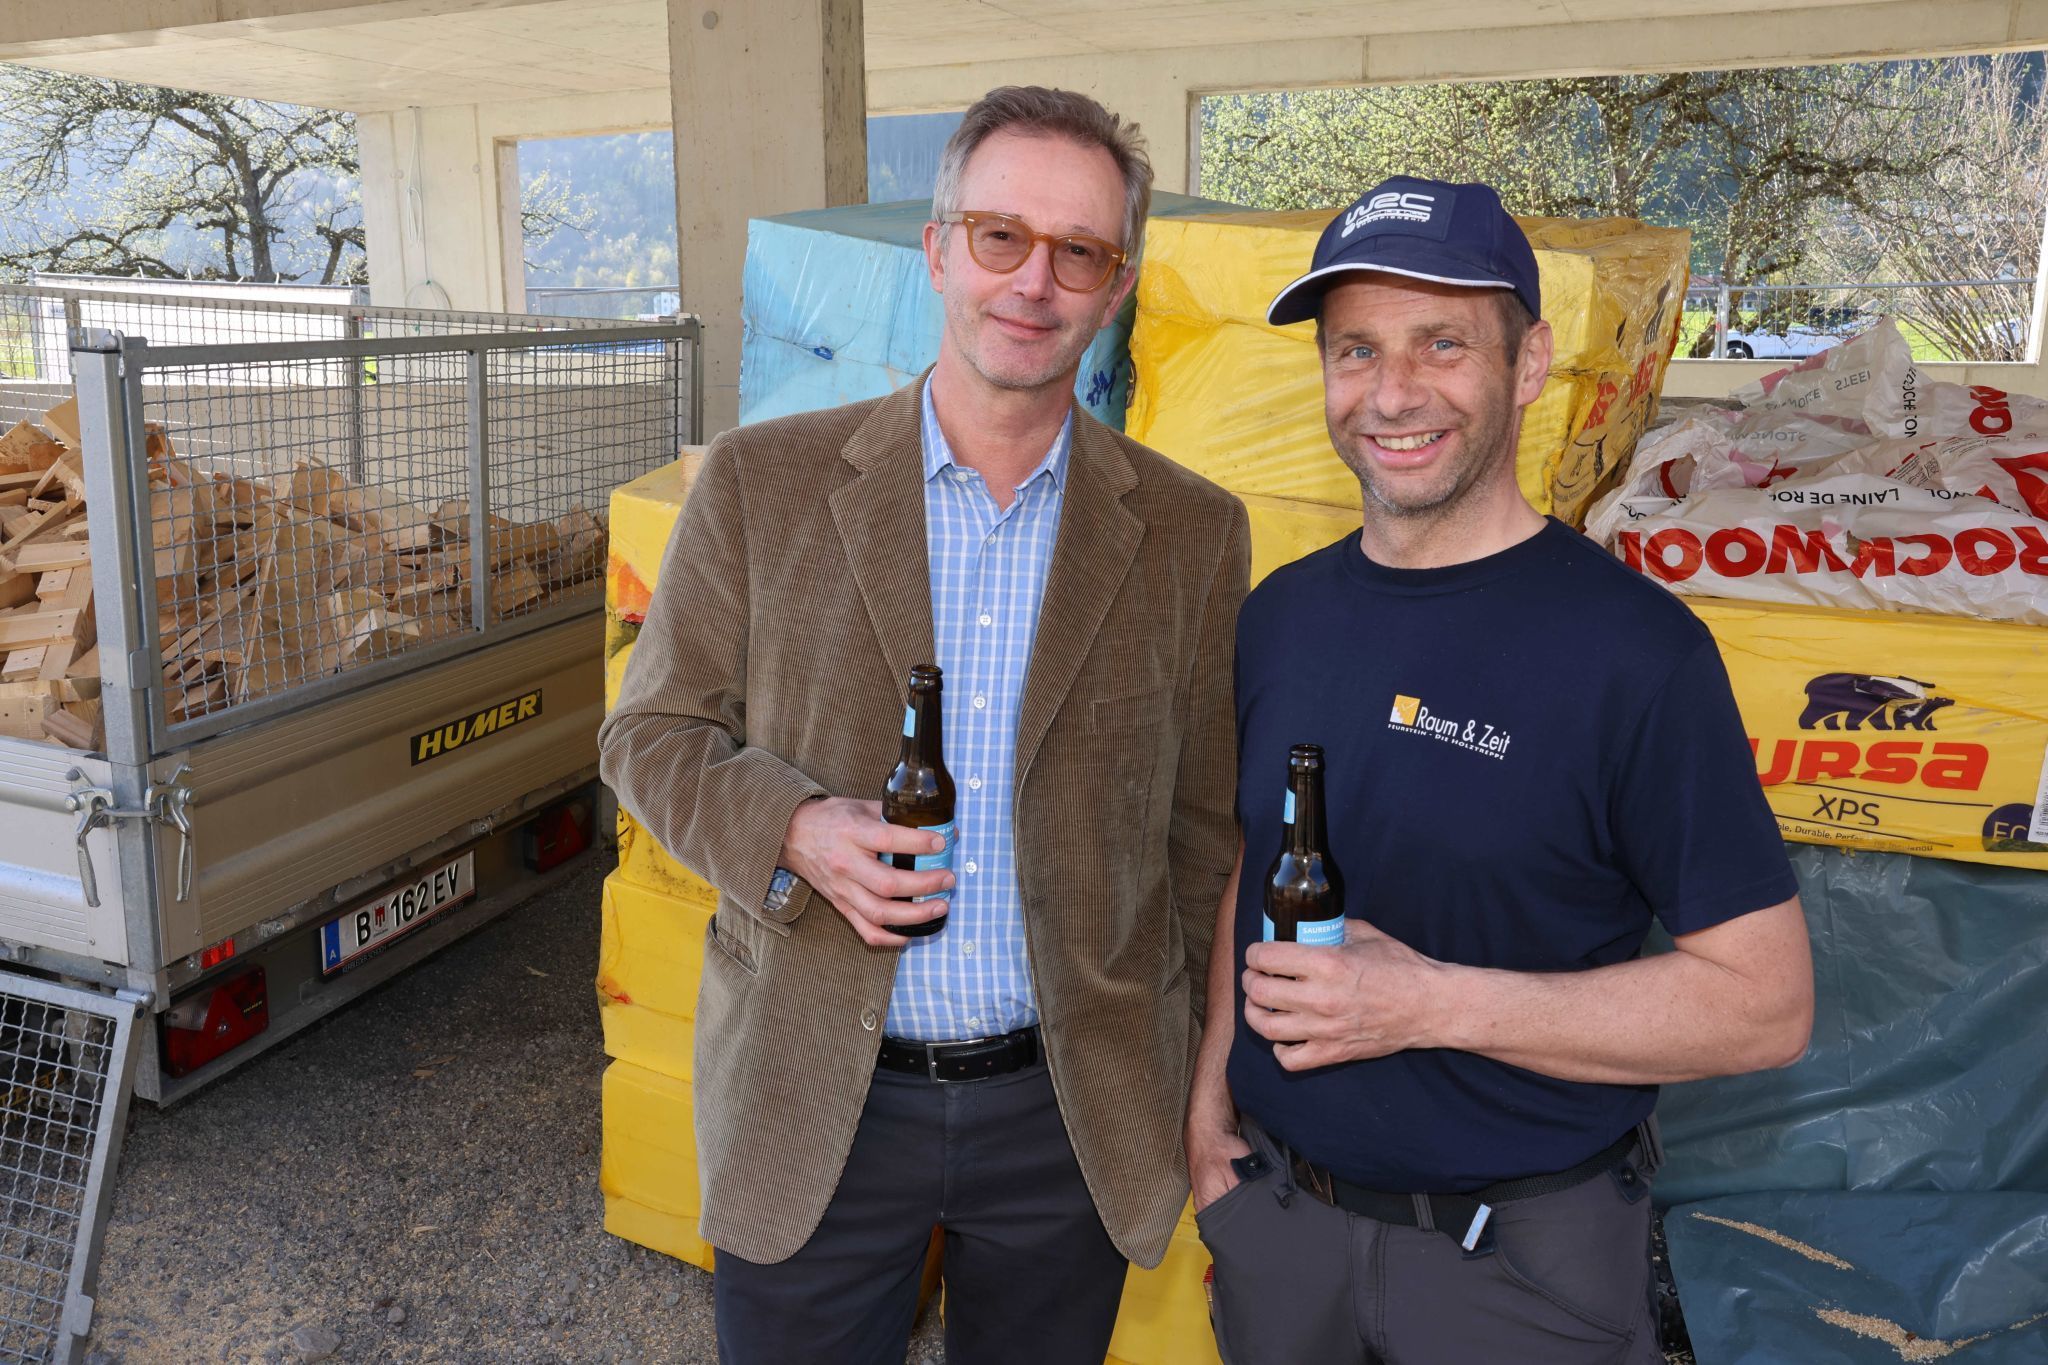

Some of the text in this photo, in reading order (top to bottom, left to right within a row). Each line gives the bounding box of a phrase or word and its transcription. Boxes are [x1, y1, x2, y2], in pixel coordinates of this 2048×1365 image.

[1809, 491, 1834, 505] DE
[1841, 488, 1900, 505] LAINE
[418, 694, 538, 760] HUMER
[1388, 723, 1427, 736] FEURSTEIN
[1434, 734, 1449, 742] DIE
[1451, 738, 1505, 760] HOLZTREPPE
[1416, 706, 1511, 753] Raum & Zeit
[1812, 794, 1880, 826] XPS
[1795, 825, 1833, 840] Durable,
[355, 911, 371, 947] B
[329, 949, 337, 961] A
